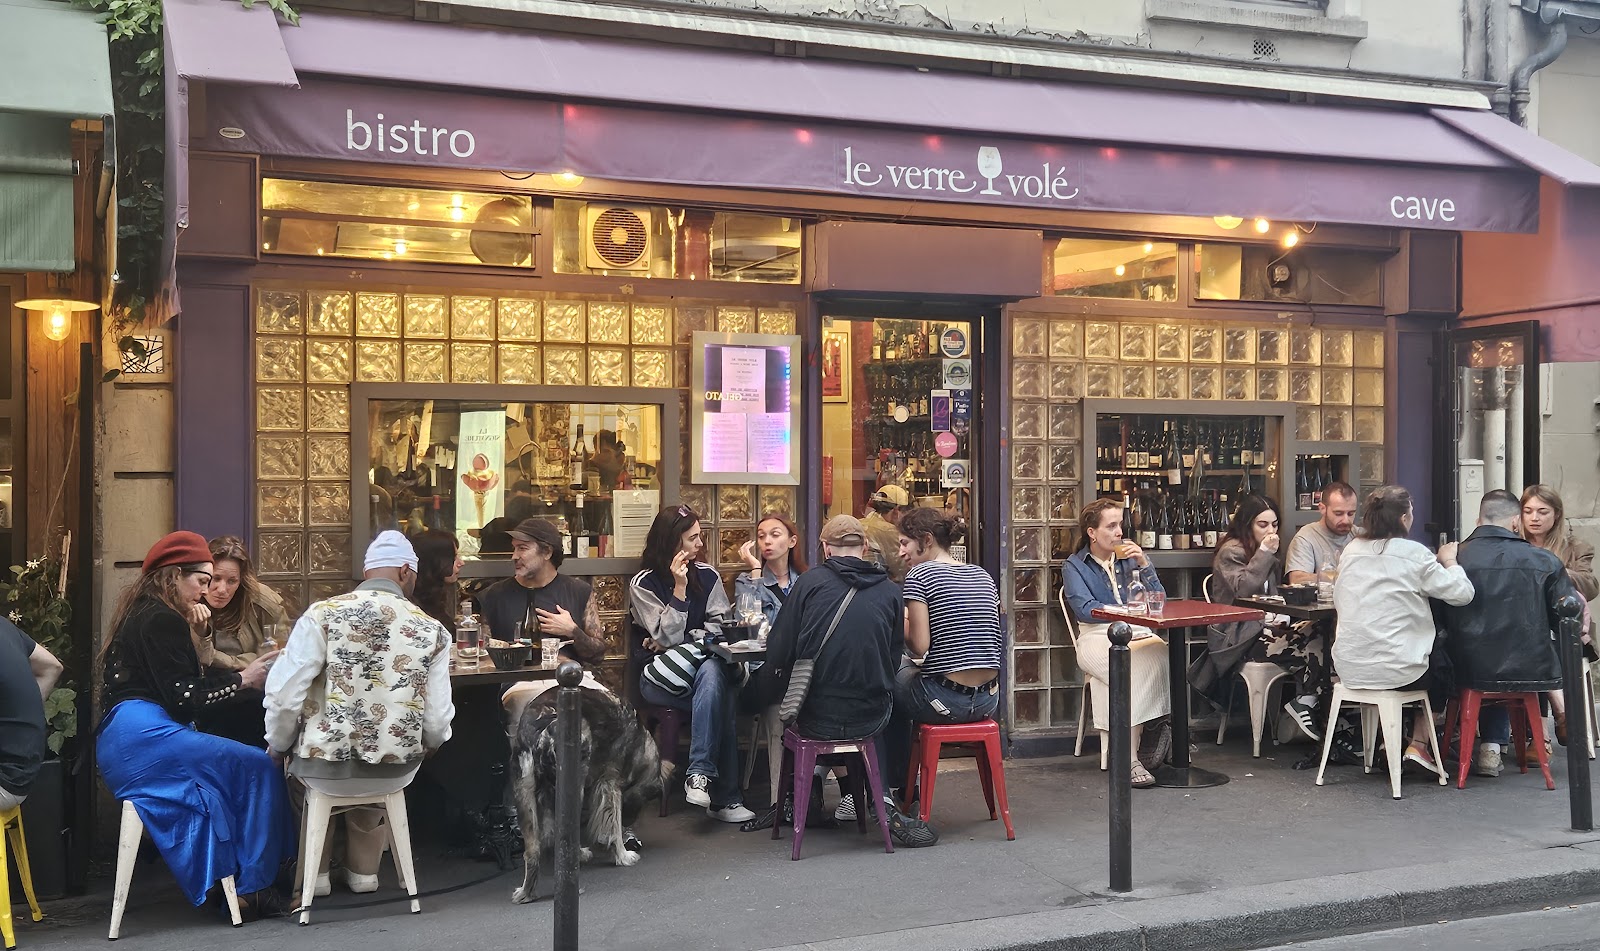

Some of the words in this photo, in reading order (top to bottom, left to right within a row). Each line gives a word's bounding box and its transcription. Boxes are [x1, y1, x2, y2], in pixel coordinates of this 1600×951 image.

[346, 108, 475, 158] bistro
[843, 146, 883, 187] le
[886, 164, 977, 193] verre
[1006, 162, 1079, 200] volé
[1390, 195, 1456, 222] cave
